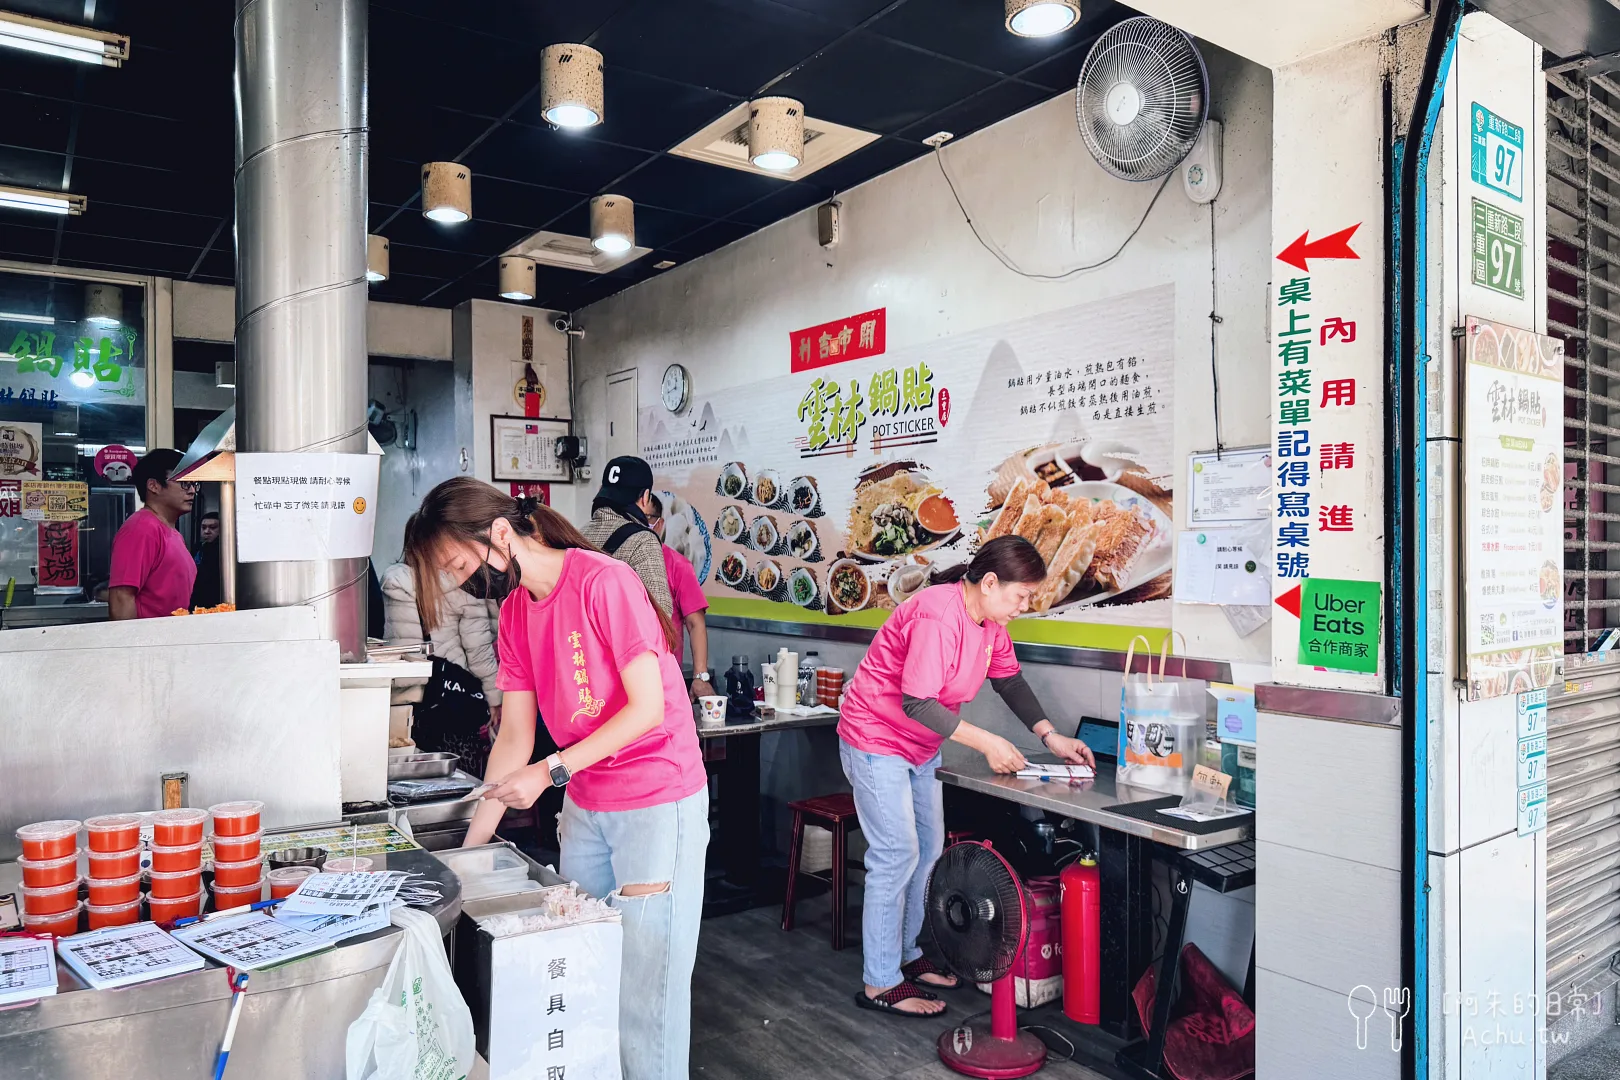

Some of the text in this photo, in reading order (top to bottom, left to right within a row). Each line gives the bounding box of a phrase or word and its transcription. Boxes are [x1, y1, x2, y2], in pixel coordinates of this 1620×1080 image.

[1488, 114, 1521, 143] 重新路二段
[1494, 144, 1515, 186] 97
[1487, 210, 1522, 241] 重新路二段
[1474, 205, 1486, 281] 三重區
[1490, 239, 1516, 289] 97
[873, 417, 935, 437] POT STICKER
[1518, 416, 1542, 427] POT STICKER
[608, 465, 621, 484] C
[283, 501, 319, 510] 忘了微笑
[1313, 592, 1366, 615] Uber
[1312, 613, 1365, 637] Eats
[1307, 638, 1369, 658] 合作商家
[567, 630, 592, 704] 雲林鍋貼
[1527, 712, 1538, 732] 97
[1527, 760, 1538, 780] 97
[1528, 808, 1539, 829] 97
[546, 957, 567, 1080] 餐具自取
